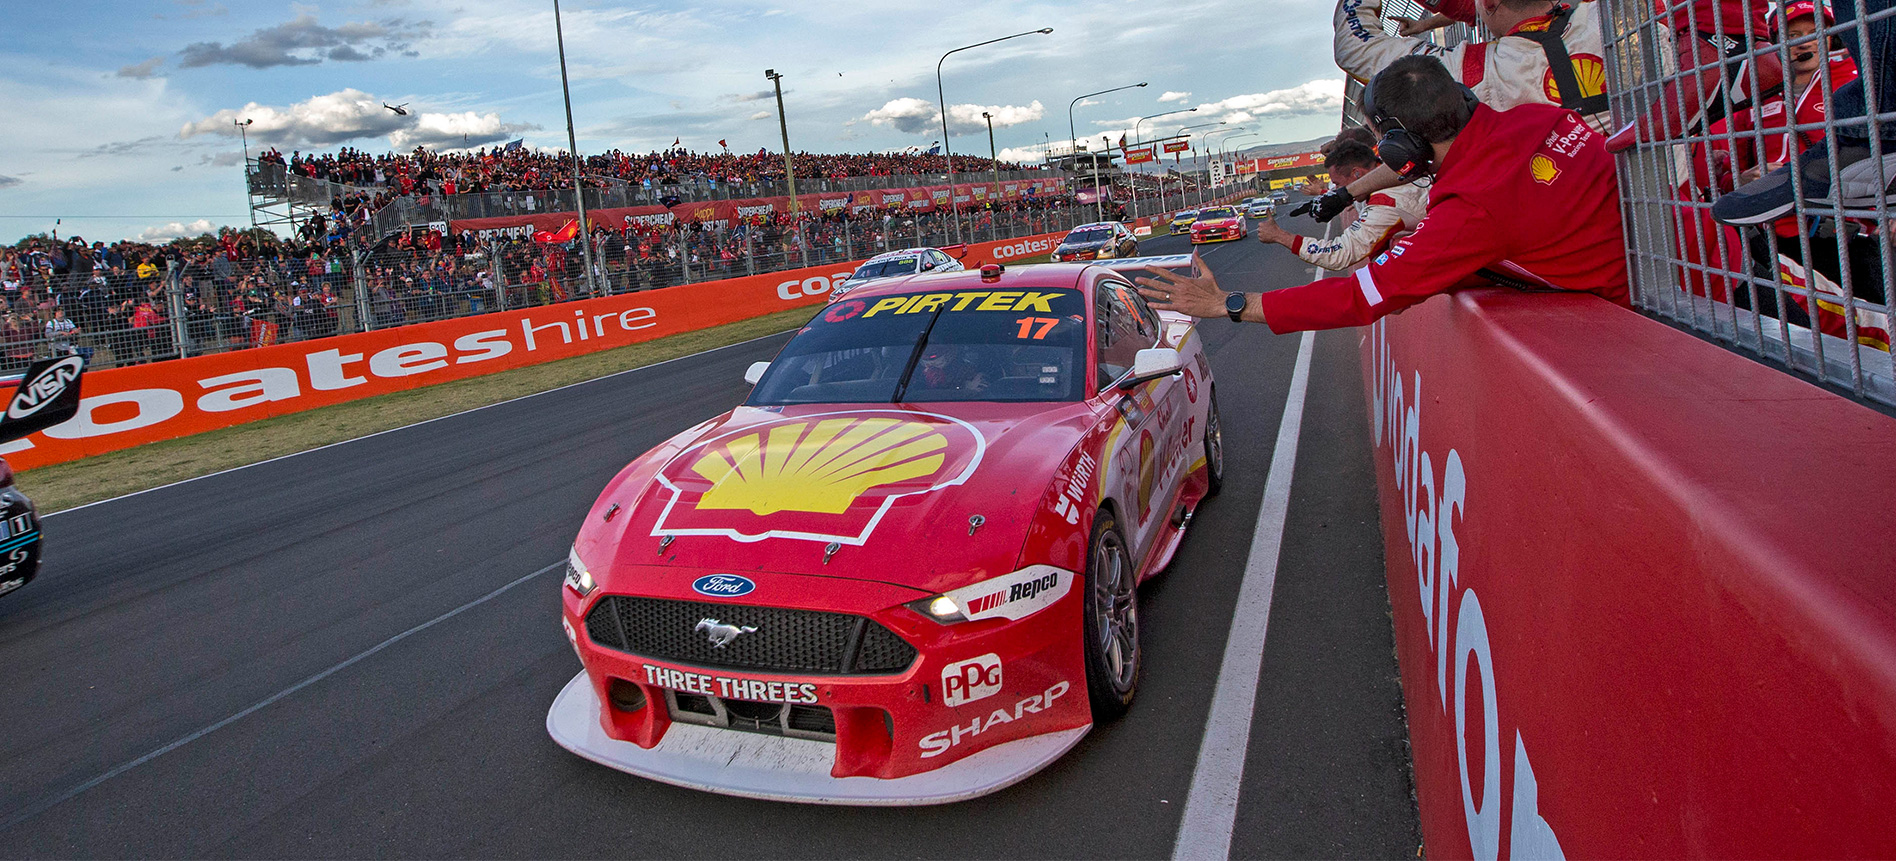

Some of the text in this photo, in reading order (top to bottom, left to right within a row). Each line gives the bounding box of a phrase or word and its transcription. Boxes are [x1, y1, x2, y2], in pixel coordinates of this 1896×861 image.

[1545, 130, 1559, 147] Shell
[737, 203, 774, 219] SUPERCHEAP
[462, 224, 534, 242] SPERCHEAP
[862, 291, 1066, 318] PIRTEK
[1015, 316, 1060, 340] 17
[0, 306, 656, 456] oateshire
[17, 366, 76, 408] VISA
[702, 576, 744, 594] Ford
[1008, 571, 1058, 603] Repco
[642, 664, 818, 704] THREE THREES
[944, 661, 1000, 700] PPG
[918, 680, 1071, 759] SHARP
